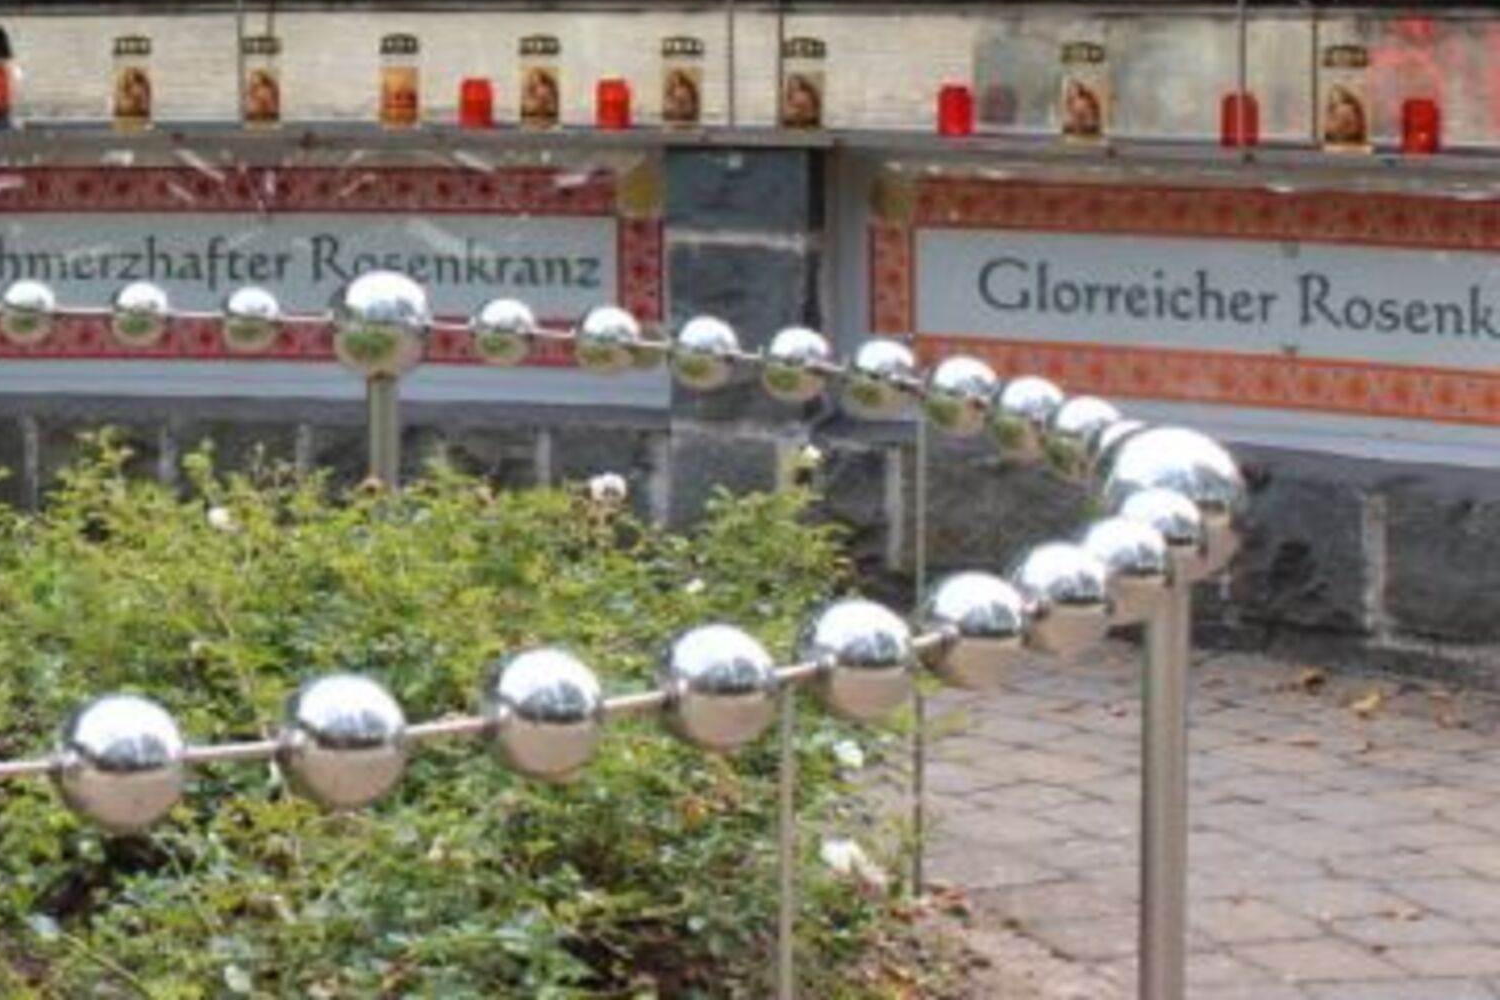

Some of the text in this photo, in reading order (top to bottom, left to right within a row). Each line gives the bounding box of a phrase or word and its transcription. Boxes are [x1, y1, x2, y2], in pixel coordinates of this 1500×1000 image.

[311, 233, 601, 287] Rosenkranz
[977, 256, 1500, 339] Glorreicher Rosenk
